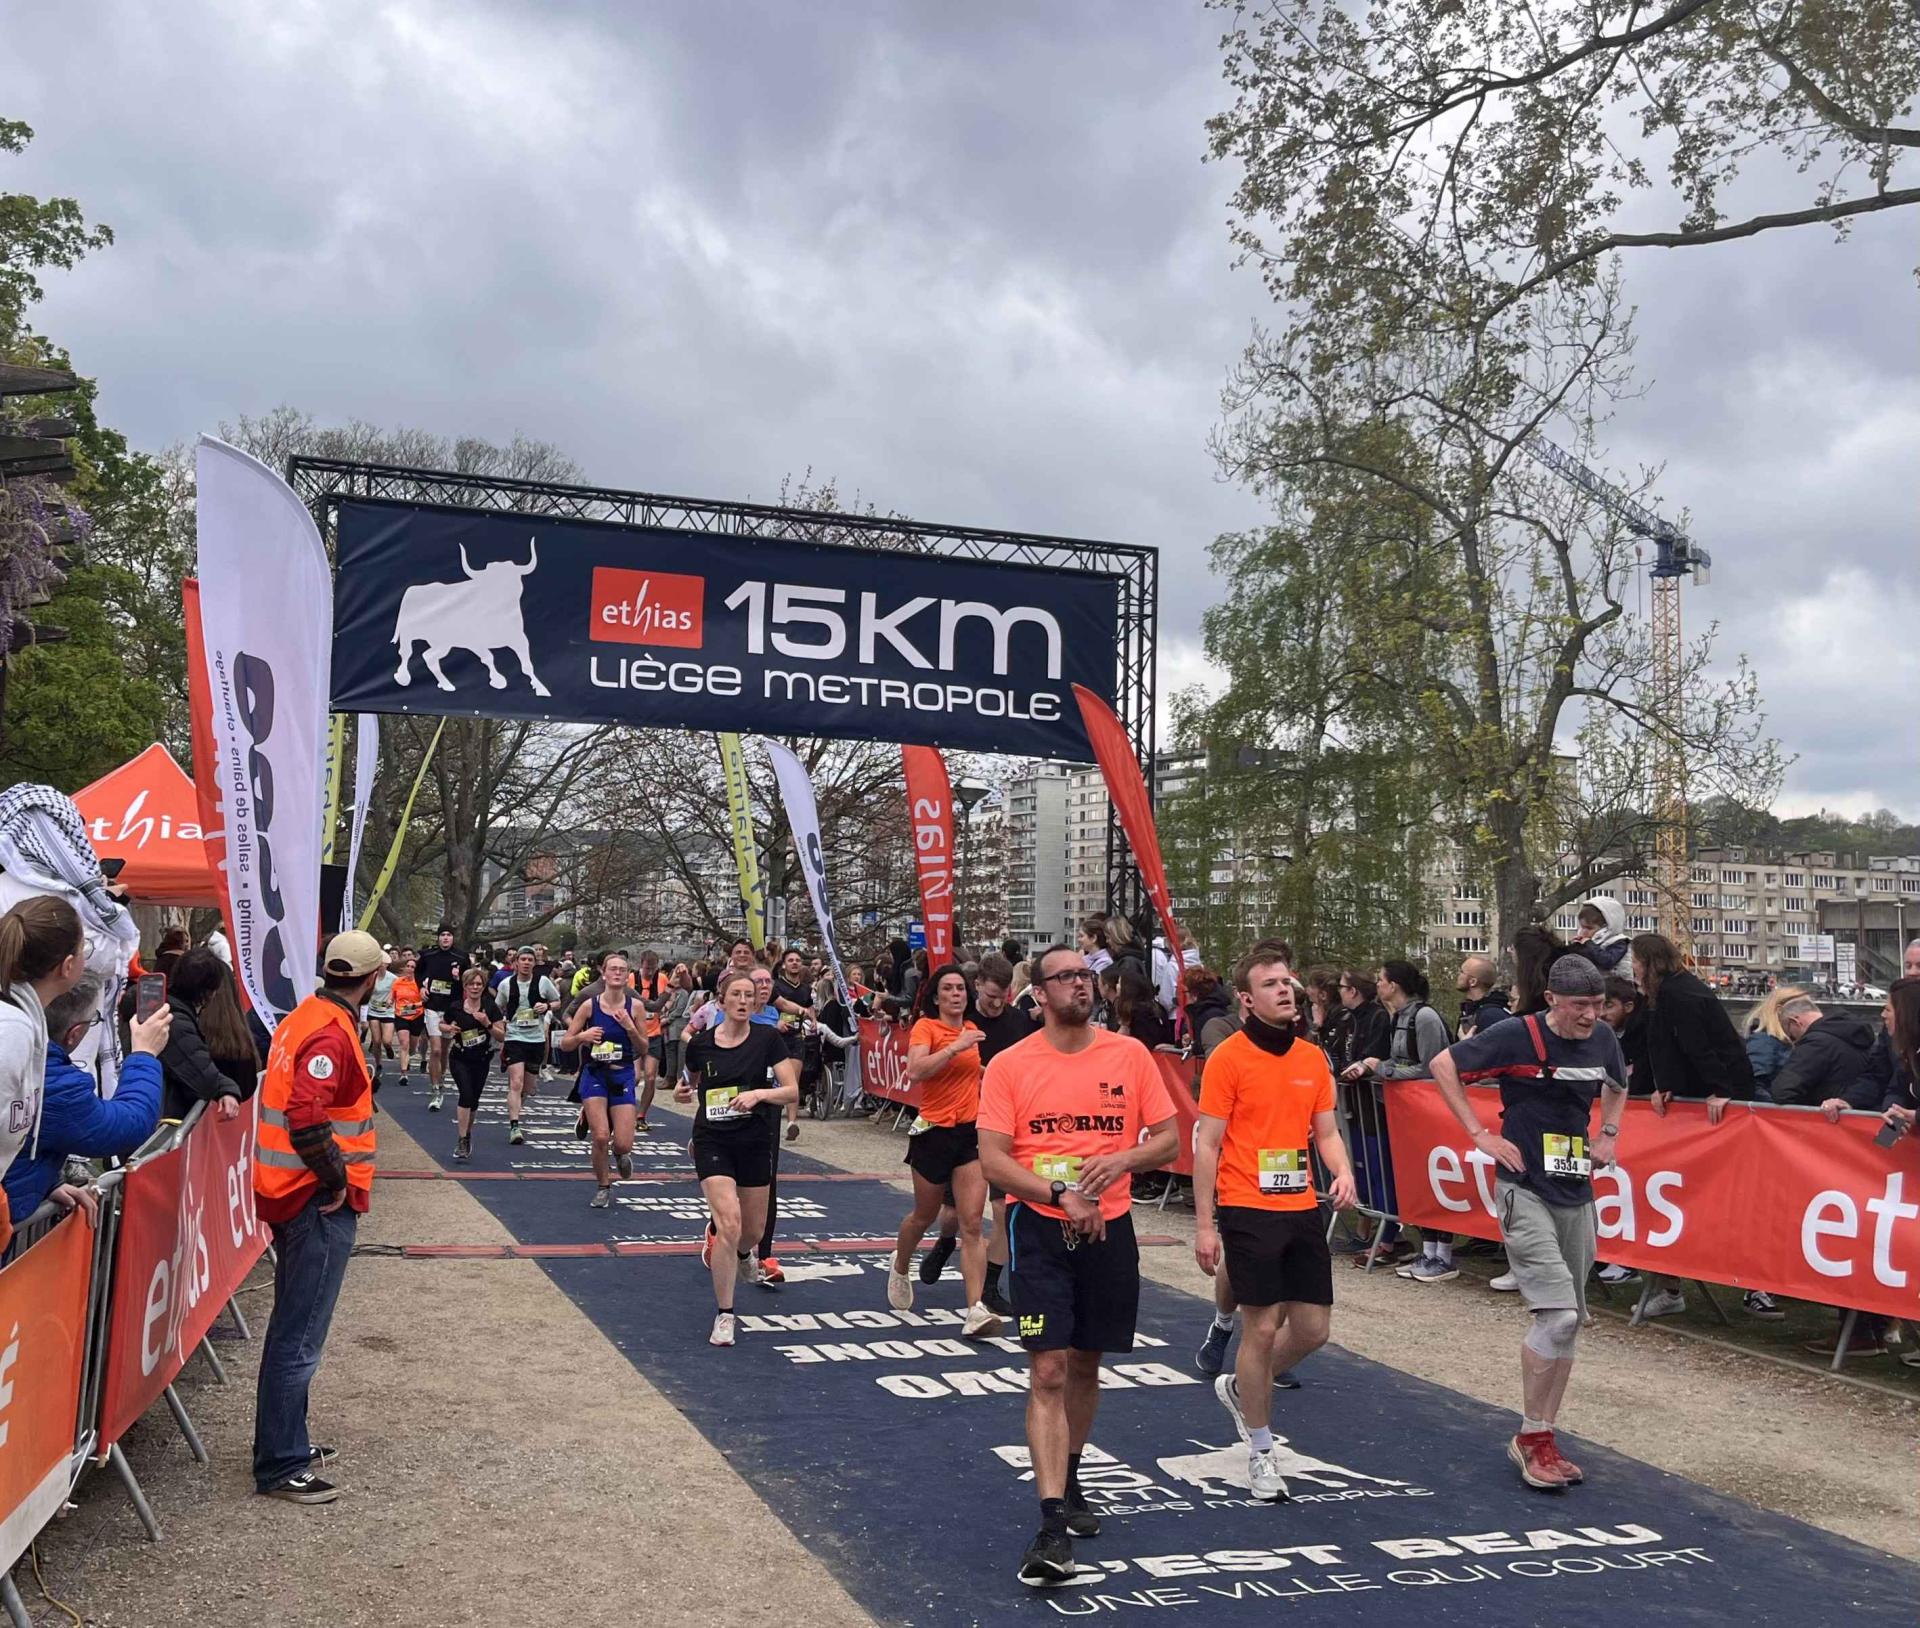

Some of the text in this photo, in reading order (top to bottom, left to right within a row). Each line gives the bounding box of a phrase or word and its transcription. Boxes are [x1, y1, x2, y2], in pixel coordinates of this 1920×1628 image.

[602, 579, 692, 636] ethias
[764, 669, 1062, 721] METROPOLE
[88, 790, 203, 848] thia
[1273, 1174, 1290, 1186] 272
[1554, 1158, 1578, 1172] 3534
[1428, 1145, 1684, 1247] etas
[1801, 1171, 1920, 1298] et
[1020, 1314, 1044, 1329] MJ
[773, 1338, 977, 1364] DONE
[1204, 1488, 1434, 1510] MEROPOLE
[1370, 1524, 1663, 1560] BEAU
[1047, 1547, 1714, 1615] UNE VILLE QUI COURT
